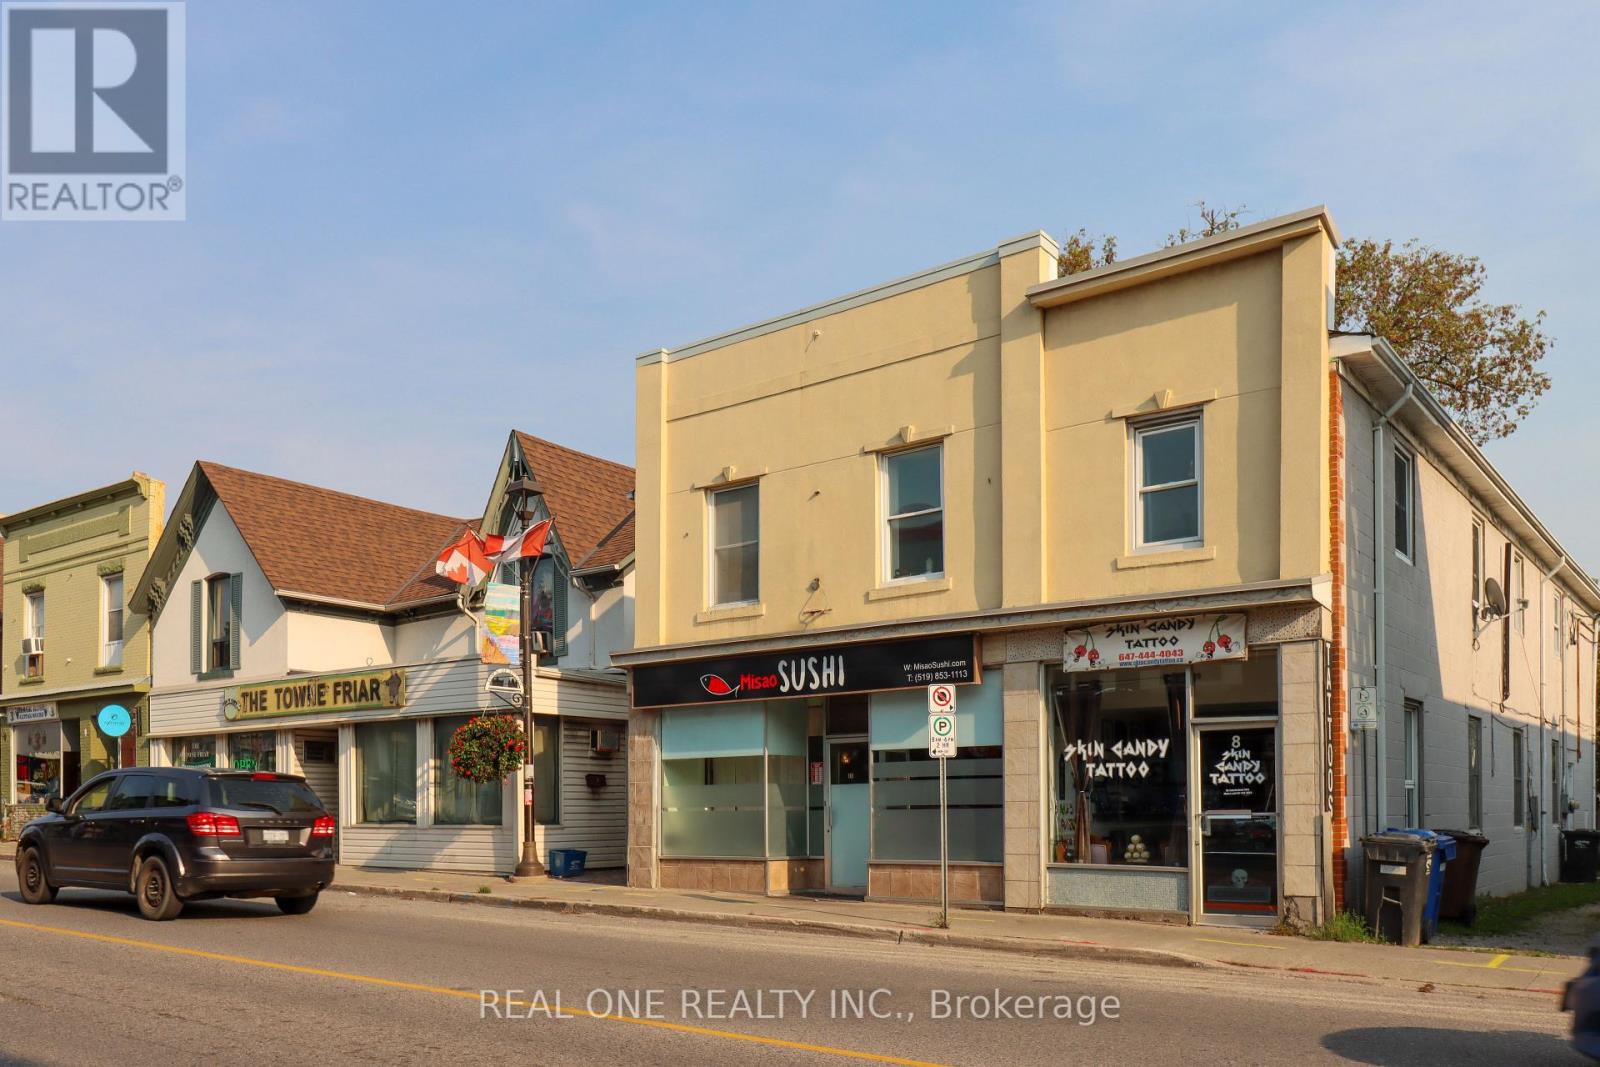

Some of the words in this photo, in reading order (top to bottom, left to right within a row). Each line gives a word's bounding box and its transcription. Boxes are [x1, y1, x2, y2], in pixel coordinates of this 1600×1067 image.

[1105, 623, 1140, 638] SKIN
[1147, 617, 1195, 633] CANDY
[1125, 635, 1179, 649] TATTOO
[913, 660, 966, 671] MisaoSushi.com
[739, 673, 778, 691] Misao
[777, 654, 845, 693] SUSHI
[907, 674, 913, 682] T:
[914, 672, 934, 682] (519)
[935, 669, 968, 680] 853-1113
[241, 689, 268, 713] THE
[333, 678, 381, 705] FRIAR
[939, 721, 947, 731] P
[1231, 735, 1241, 749] 8
[1063, 739, 1105, 762] SKIN
[1110, 738, 1170, 760] CANDY
[1222, 748, 1251, 761] SKIN
[1086, 761, 1150, 779] TATTOO
[1214, 760, 1261, 773] CANDY
[1209, 772, 1265, 786] TATTOO
